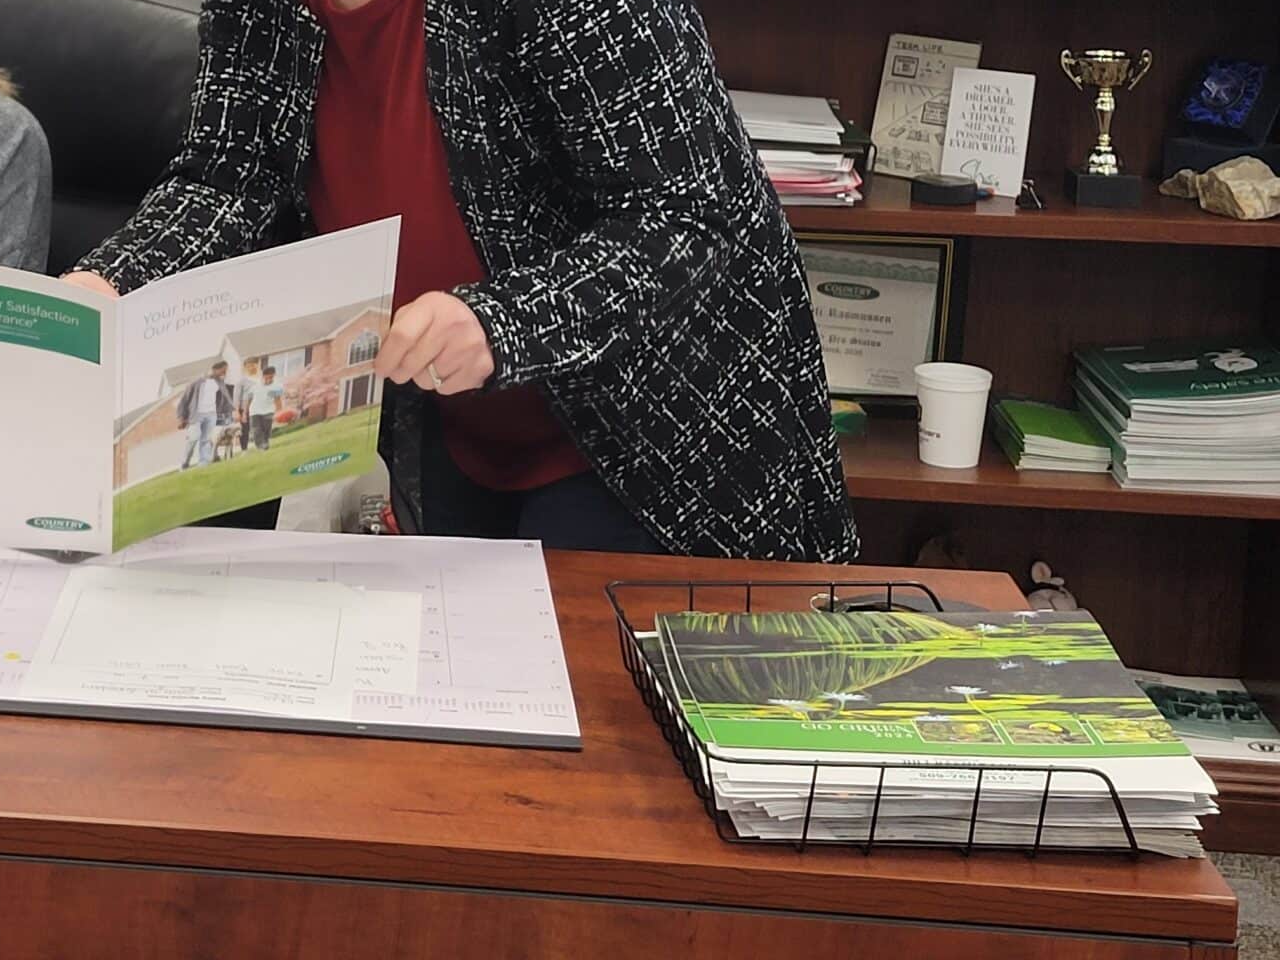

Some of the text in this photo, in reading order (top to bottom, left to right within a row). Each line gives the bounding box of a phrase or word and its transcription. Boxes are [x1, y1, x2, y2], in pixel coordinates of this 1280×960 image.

[6, 300, 80, 327] Satisfaction
[143, 305, 177, 325] Your
[143, 323, 170, 340] Our
[296, 453, 343, 474] COUNTRY
[34, 517, 84, 529] COUNTRY
